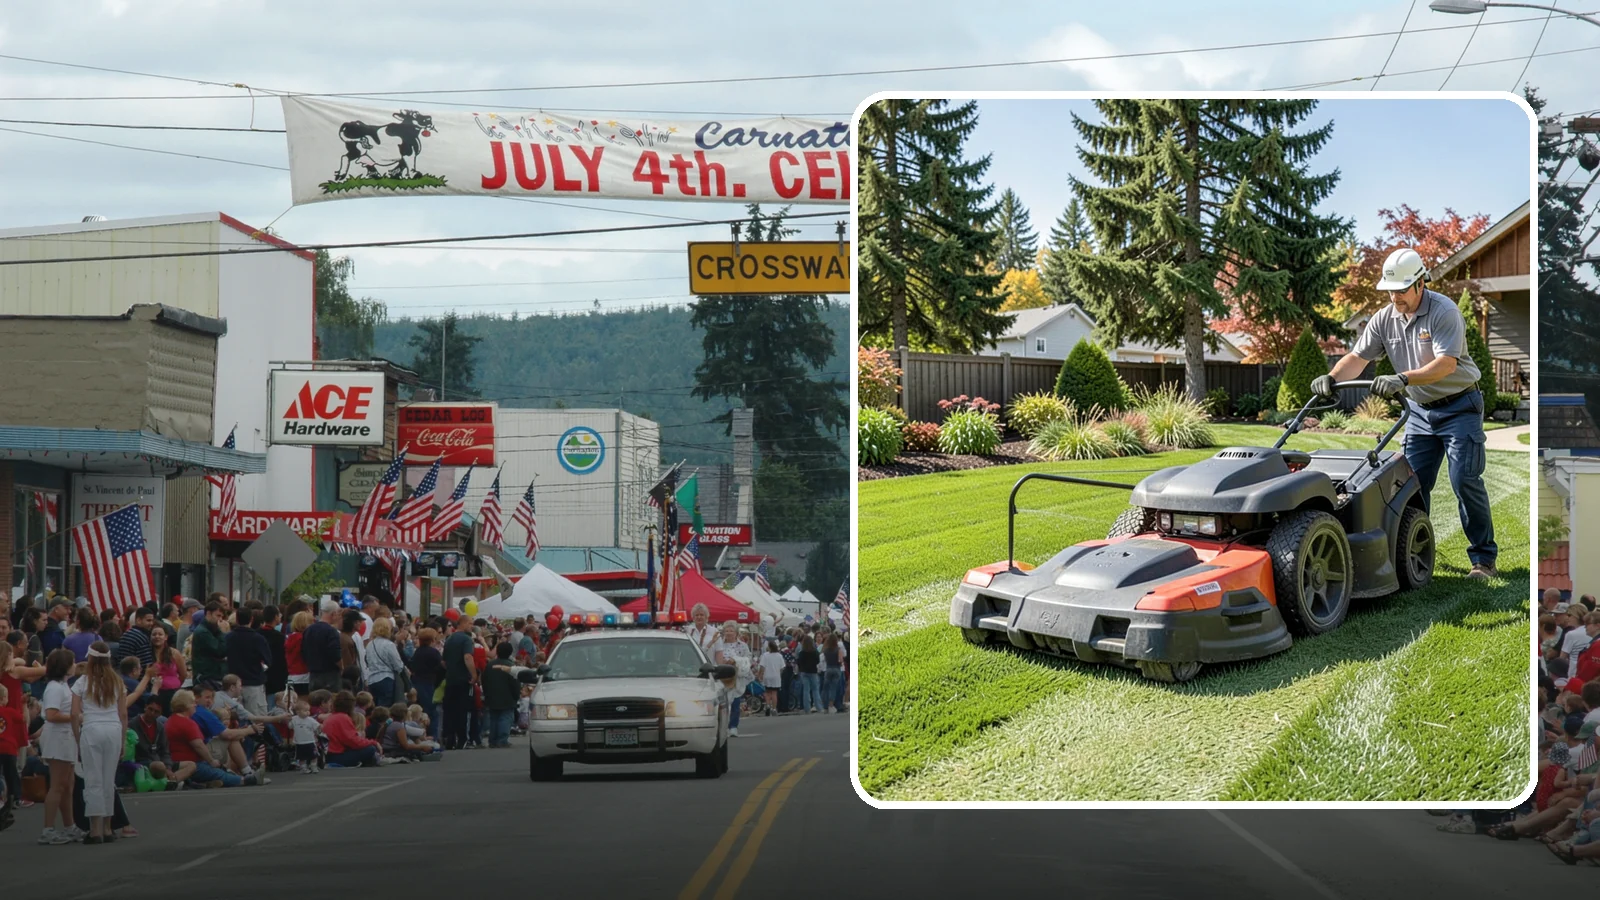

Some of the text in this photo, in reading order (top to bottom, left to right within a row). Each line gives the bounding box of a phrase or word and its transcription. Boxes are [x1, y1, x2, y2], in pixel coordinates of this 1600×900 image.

[695, 121, 850, 150] Carnat
[481, 140, 605, 192] JULY
[632, 150, 746, 198] 4th.
[697, 254, 850, 280] CROSSWA
[283, 380, 373, 419] ACE
[405, 409, 485, 422] CEDAR LOG
[283, 421, 371, 437] Hardware
[95, 485, 124, 495] Vincent
[126, 486, 136, 495] de
[137, 486, 155, 495] Paul
[688, 526, 741, 535] CRNATION
[699, 535, 730, 543] GLASS
